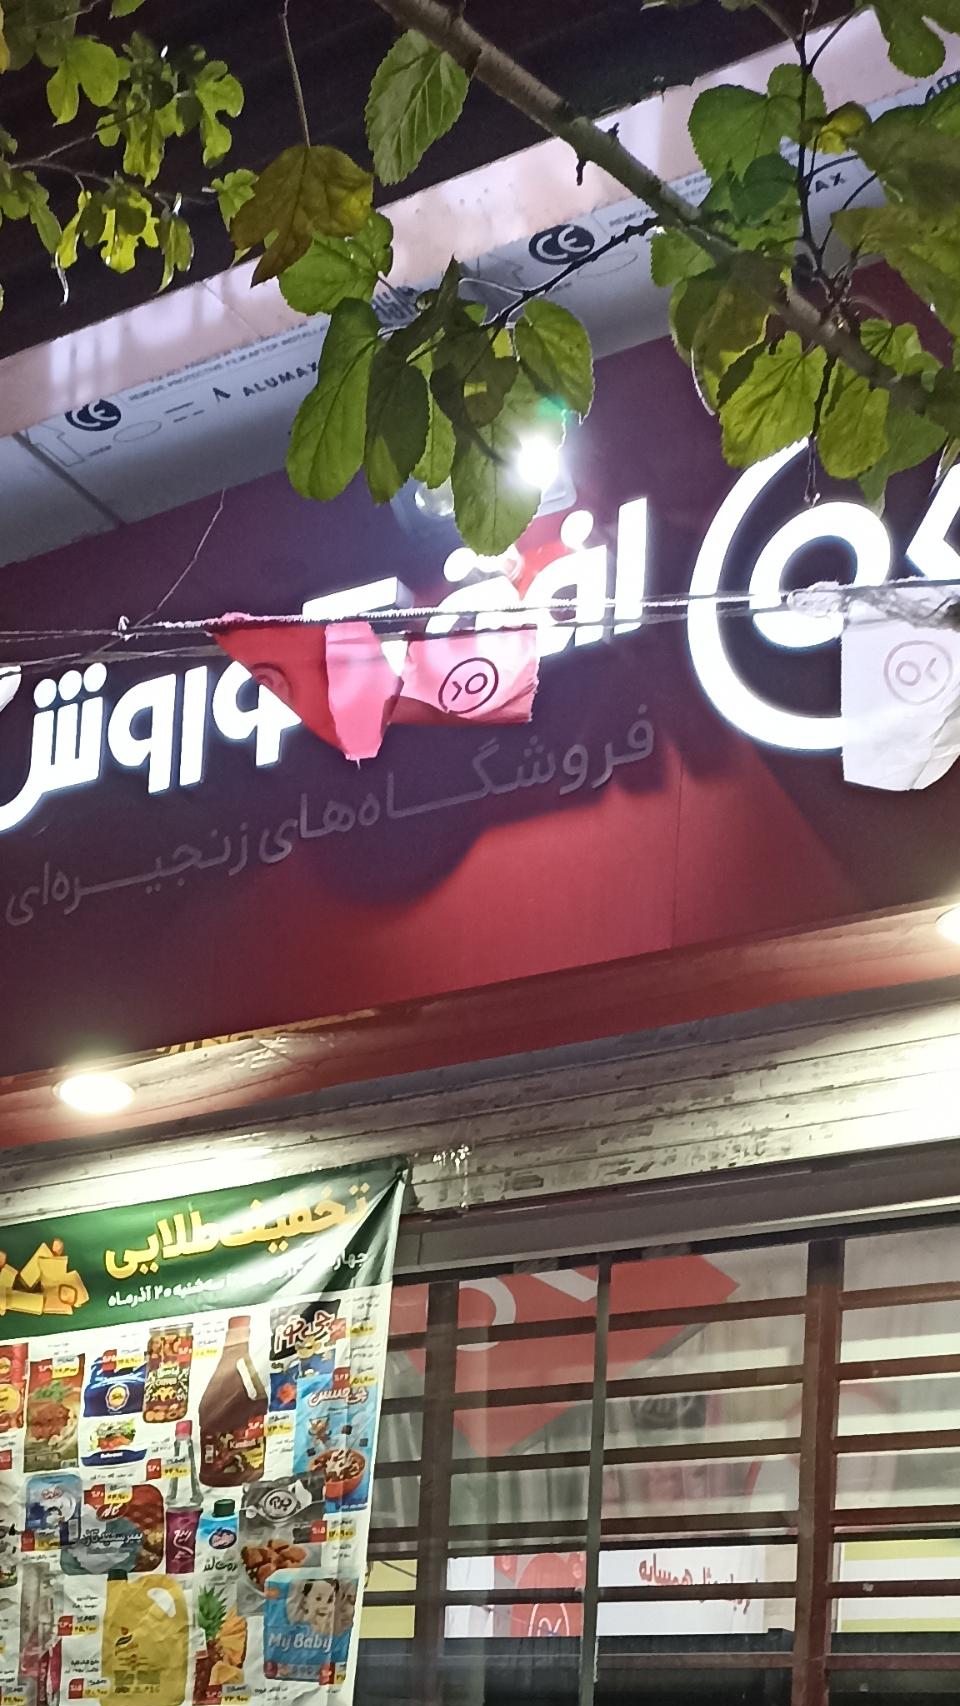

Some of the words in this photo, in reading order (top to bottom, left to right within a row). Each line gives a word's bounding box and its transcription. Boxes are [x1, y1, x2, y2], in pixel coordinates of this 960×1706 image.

[104, 1209, 221, 1279] طلایی
[268, 1632, 292, 1652] My
[293, 1632, 333, 1653] Baby
